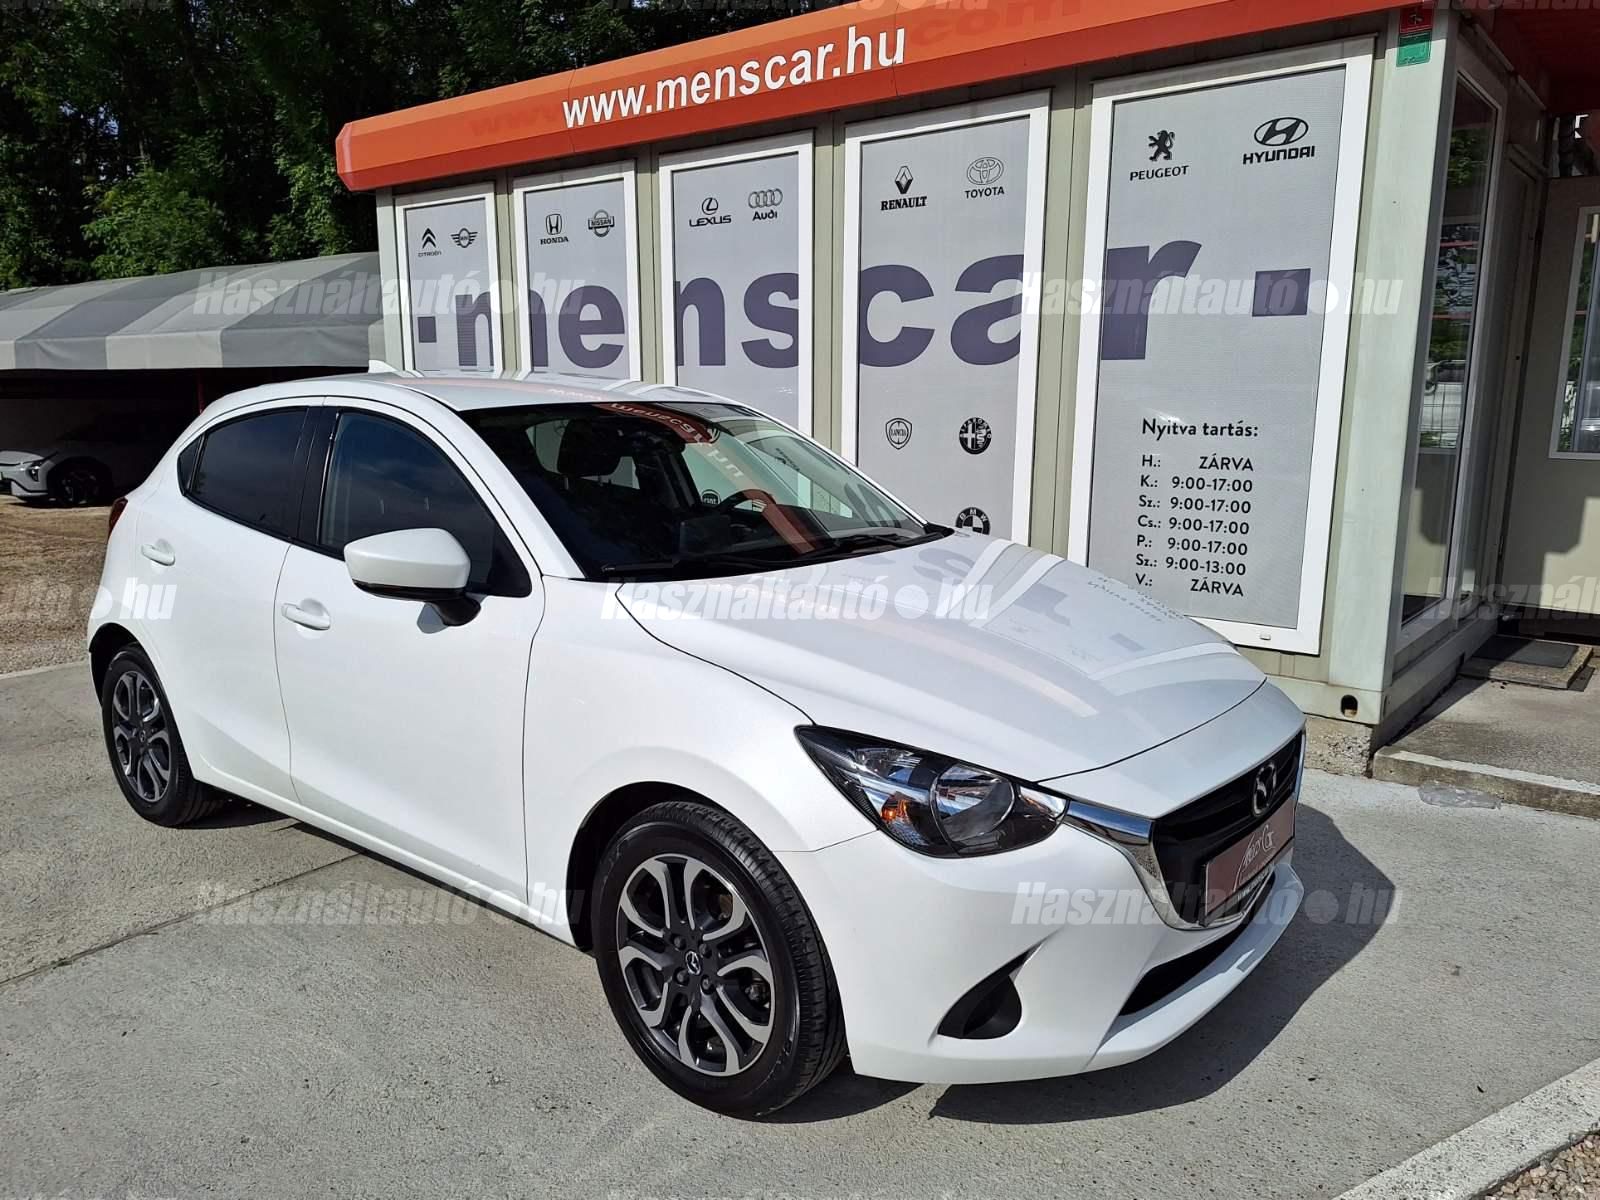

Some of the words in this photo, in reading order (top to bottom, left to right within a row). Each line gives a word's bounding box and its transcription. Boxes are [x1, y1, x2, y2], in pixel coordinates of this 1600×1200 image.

[562, 26, 906, 128] www.menscar.hu
[1242, 145, 1316, 165] HYUNDAI
[1129, 165, 1190, 181] PEUGEOT
[964, 186, 1005, 199] TOYOTA
[880, 196, 928, 211] RENAULT
[688, 214, 732, 228] LEXUS
[752, 209, 778, 222] Audi
[540, 236, 569, 246] HONDA
[1142, 418, 1197, 441] Nyitva
[1202, 420, 1259, 437] tartás:
[1141, 454, 1161, 468] H.:
[1198, 453, 1254, 472] ZÁRVA
[1140, 474, 1158, 488] K.:
[1171, 476, 1253, 493] 9:00-17:00
[1138, 494, 1161, 508] Sz.:
[1170, 496, 1252, 514] 9:00-17:00
[1137, 514, 1161, 529] Cs.:
[1168, 517, 1250, 535] 9:00-17:00
[1136, 534, 1152, 548] P.:
[1167, 537, 1248, 556] 9:00-17:00
[1135, 553, 1158, 568] Sz.:
[1165, 556, 1246, 576] 9:00-13:00
[1135, 573, 1153, 587] V.:
[1190, 576, 1244, 597] ZÁRVA
